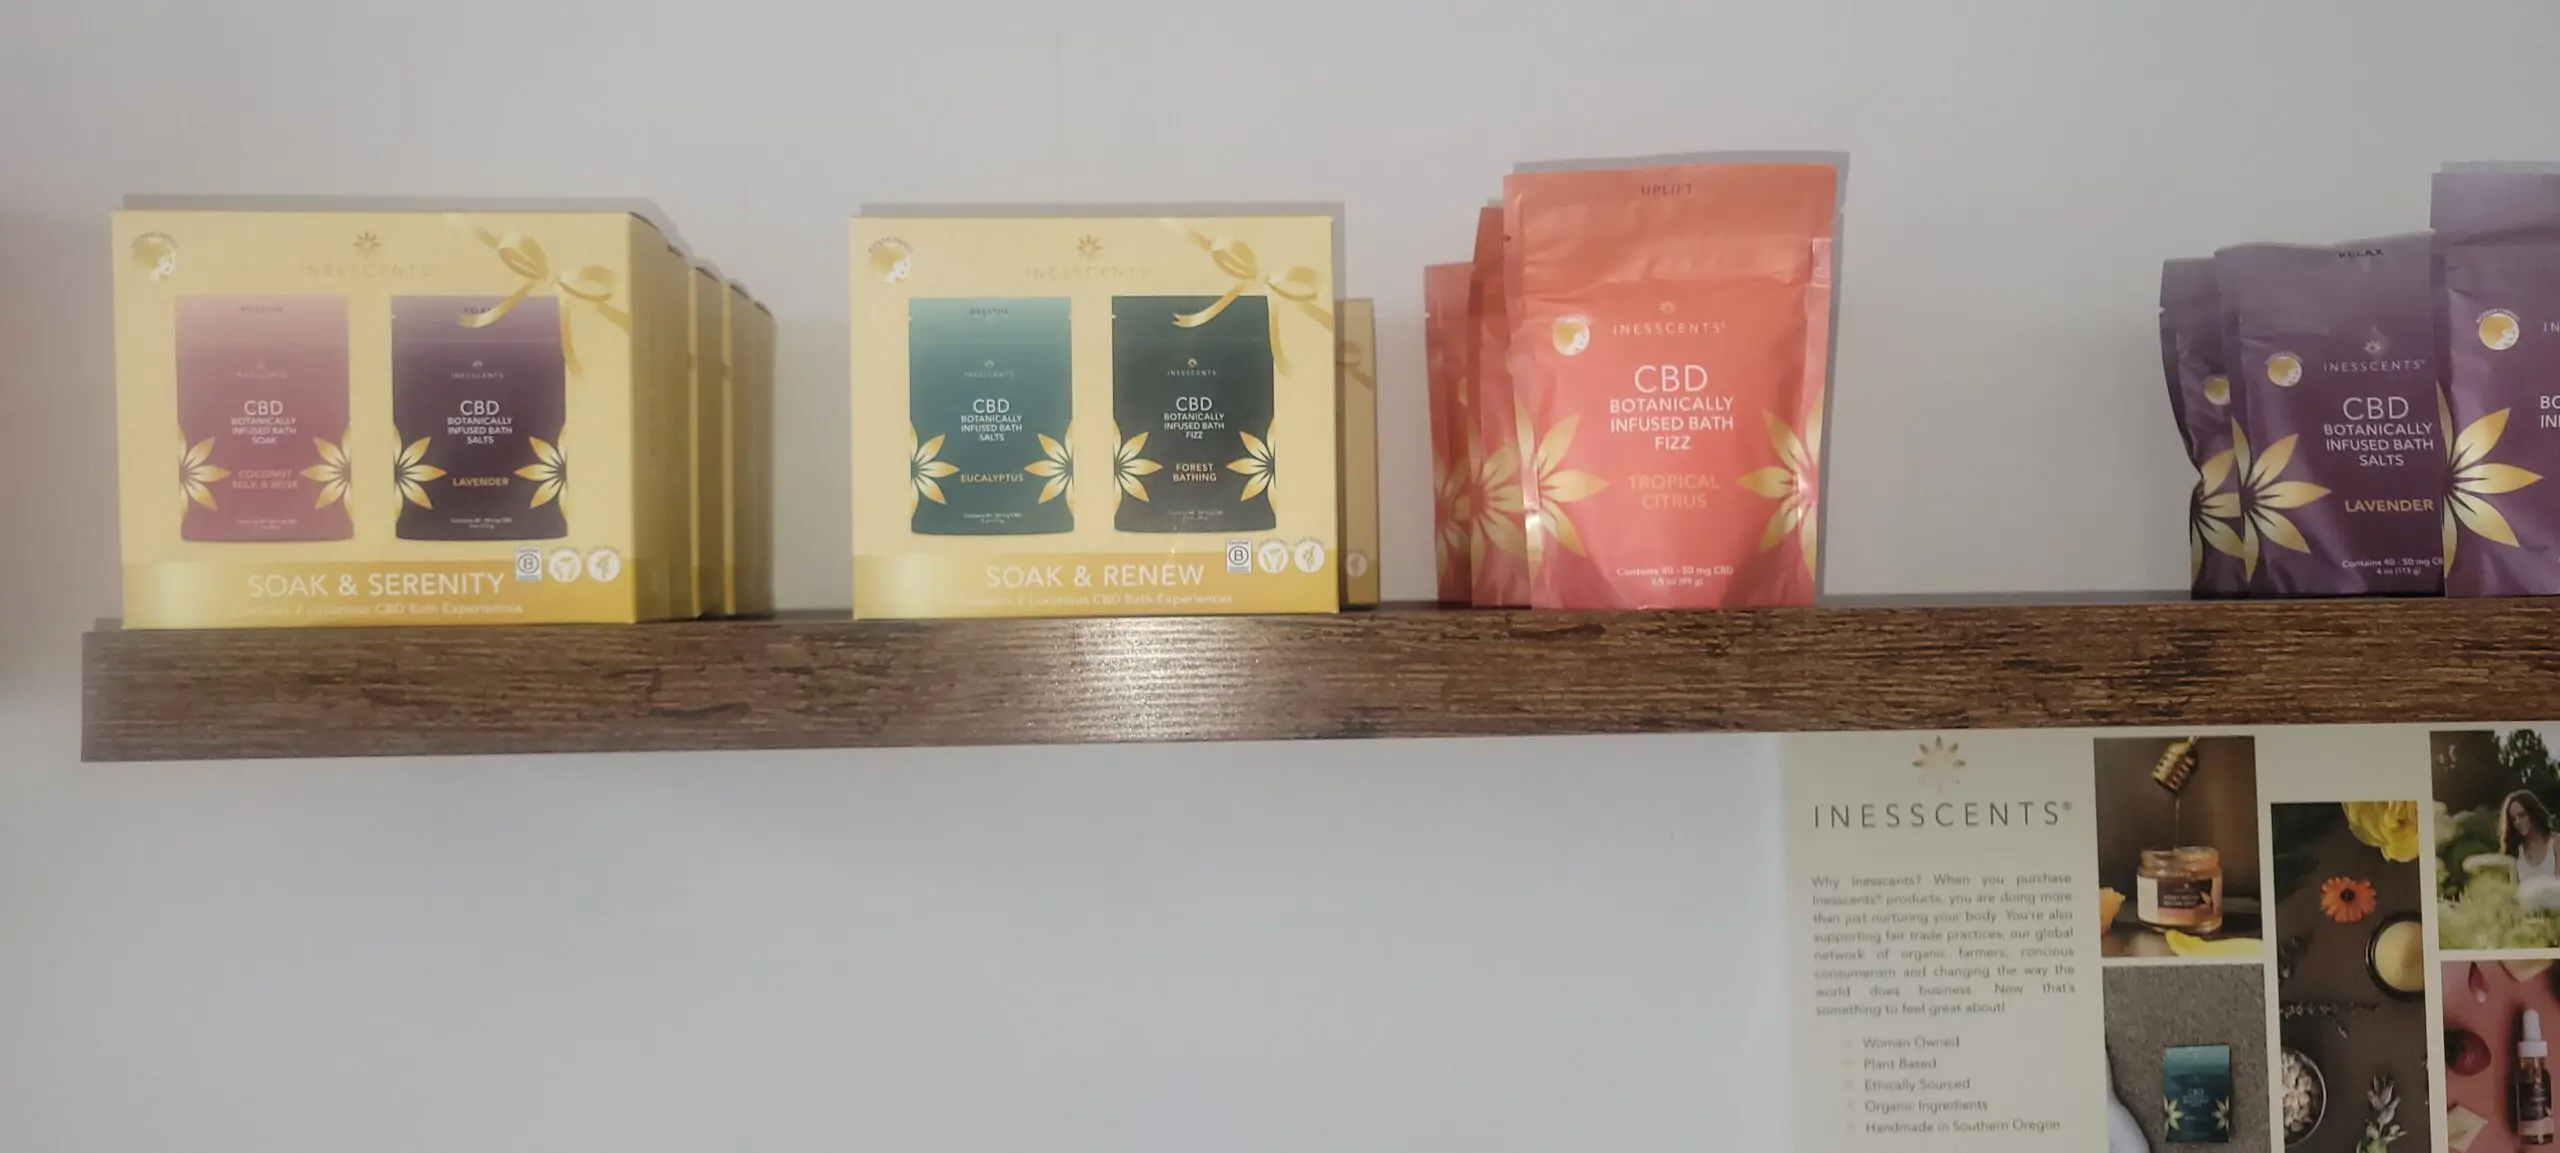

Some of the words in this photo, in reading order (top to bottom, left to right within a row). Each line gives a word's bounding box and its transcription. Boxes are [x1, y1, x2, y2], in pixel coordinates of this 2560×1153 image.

[1641, 183, 1693, 196] UPLIFT
[2338, 248, 2384, 259] RELAX
[1634, 364, 1708, 393] CBD
[244, 400, 283, 416] CBD
[460, 400, 500, 416] CBD
[973, 398, 1010, 414] CBD
[1176, 396, 1213, 412] CBD
[1609, 396, 1734, 414] BOTANICALLY
[2342, 396, 2410, 421] CBD
[231, 417, 297, 427] BOTANICALLY
[447, 417, 514, 426] BOTANICALLY
[961, 415, 1023, 424] BOTANICALLY
[1164, 413, 1225, 421] BOTANICALLY
[232, 426, 270, 436] INFUSED
[272, 426, 297, 435] BATH
[447, 426, 486, 436] INFUSED
[488, 426, 513, 435] BATH
[961, 424, 998, 433] INFUSED
[999, 424, 1022, 433] BATH
[1164, 422, 1200, 430] INFUSED
[1202, 421, 1225, 430] BATH
[1611, 417, 1683, 433] INFUSED
[1689, 416, 1733, 431] BATH
[2323, 422, 2433, 436] BOTANICALLY
[252, 436, 278, 445] SOAK
[467, 435, 494, 445] SALTS
[979, 433, 1005, 442] SALTS
[1185, 431, 1203, 440] FIZZ
[1655, 436, 1692, 451] FIZZ
[2326, 439, 2389, 452] INFUSED
[2393, 439, 2434, 451] BATH
[2359, 454, 2404, 467] SALTS
[1176, 463, 1214, 473] FOREST
[452, 477, 510, 487] LAVENDER
[960, 473, 1024, 484] EUCALYPTUS
[1173, 473, 1217, 483] BATHING
[1628, 474, 1720, 490] TROPICAL
[1641, 494, 1708, 510] CITRUS
[2345, 499, 2435, 513] LAVENDER
[1714, 565, 1734, 576] CBD
[2342, 559, 2382, 568] Contains
[985, 564, 1064, 589] SOAK
[1073, 564, 1092, 588] &
[1103, 563, 1205, 587] RENEW
[249, 573, 329, 597] SOAK
[339, 572, 359, 596] &
[368, 571, 505, 597] SERENITY
[1093, 594, 1121, 605] CBD
[1125, 593, 1154, 605] Bath
[1157, 592, 1234, 608] Experiences
[376, 602, 405, 616] CBD
[1811, 875, 1840, 890] Why
[1934, 873, 1970, 886] When
[1981, 875, 2005, 888] you
[2016, 872, 2072, 888] purchase
[1949, 894, 1972, 905] you
[1976, 894, 1996, 904] are
[2000, 891, 2035, 905] doing
[2040, 892, 2072, 903] more
[1813, 912, 1840, 924] than
[1844, 912, 1867, 928] just
[1871, 912, 1928, 926] nurturing
[1933, 913, 1959, 924] your
[2004, 908, 2044, 921] You're
[2048, 907, 2074, 920] also
[1813, 930, 1882, 945] supporting
[1885, 929, 1905, 940] fair
[1910, 928, 1943, 940] trade
[2009, 930, 2030, 939] our
[2035, 926, 2074, 942] global
[1814, 948, 1864, 961] network
[1876, 947, 1889, 960] of
[1900, 948, 1948, 962] organic
[1814, 967, 1897, 980] consumerism
[1903, 965, 1927, 978] and
[1933, 964, 1990, 980] changing
[1997, 964, 2018, 977] the
[2024, 966, 2048, 978] way
[2055, 963, 2075, 976] the
[1815, 984, 1850, 998] world
[1869, 983, 1900, 997] does
[1995, 981, 2024, 995] Now
[2042, 981, 2076, 995] that's
[1816, 1003, 1882, 1018] something
[1886, 1003, 1899, 1015] to
[1902, 1001, 1926, 1015] feel
[1929, 1002, 1960, 1018] great
[1862, 1036, 1911, 1049] Woman
[1914, 1035, 1960, 1049] Owned
[1864, 1056, 1896, 1071] Plant
[1899, 1056, 1937, 1070] Based
[1864, 1078, 1916, 1093] Ethically
[1919, 1077, 1970, 1091] Sourced
[1865, 1100, 1914, 1115] Organic
[1918, 1098, 1988, 1114] Ingredients
[1866, 1121, 1934, 1134] Handmade
[1938, 1121, 1951, 1133] in
[1953, 1119, 2009, 1132] Southern
[2012, 1117, 2060, 1134] Oregon
